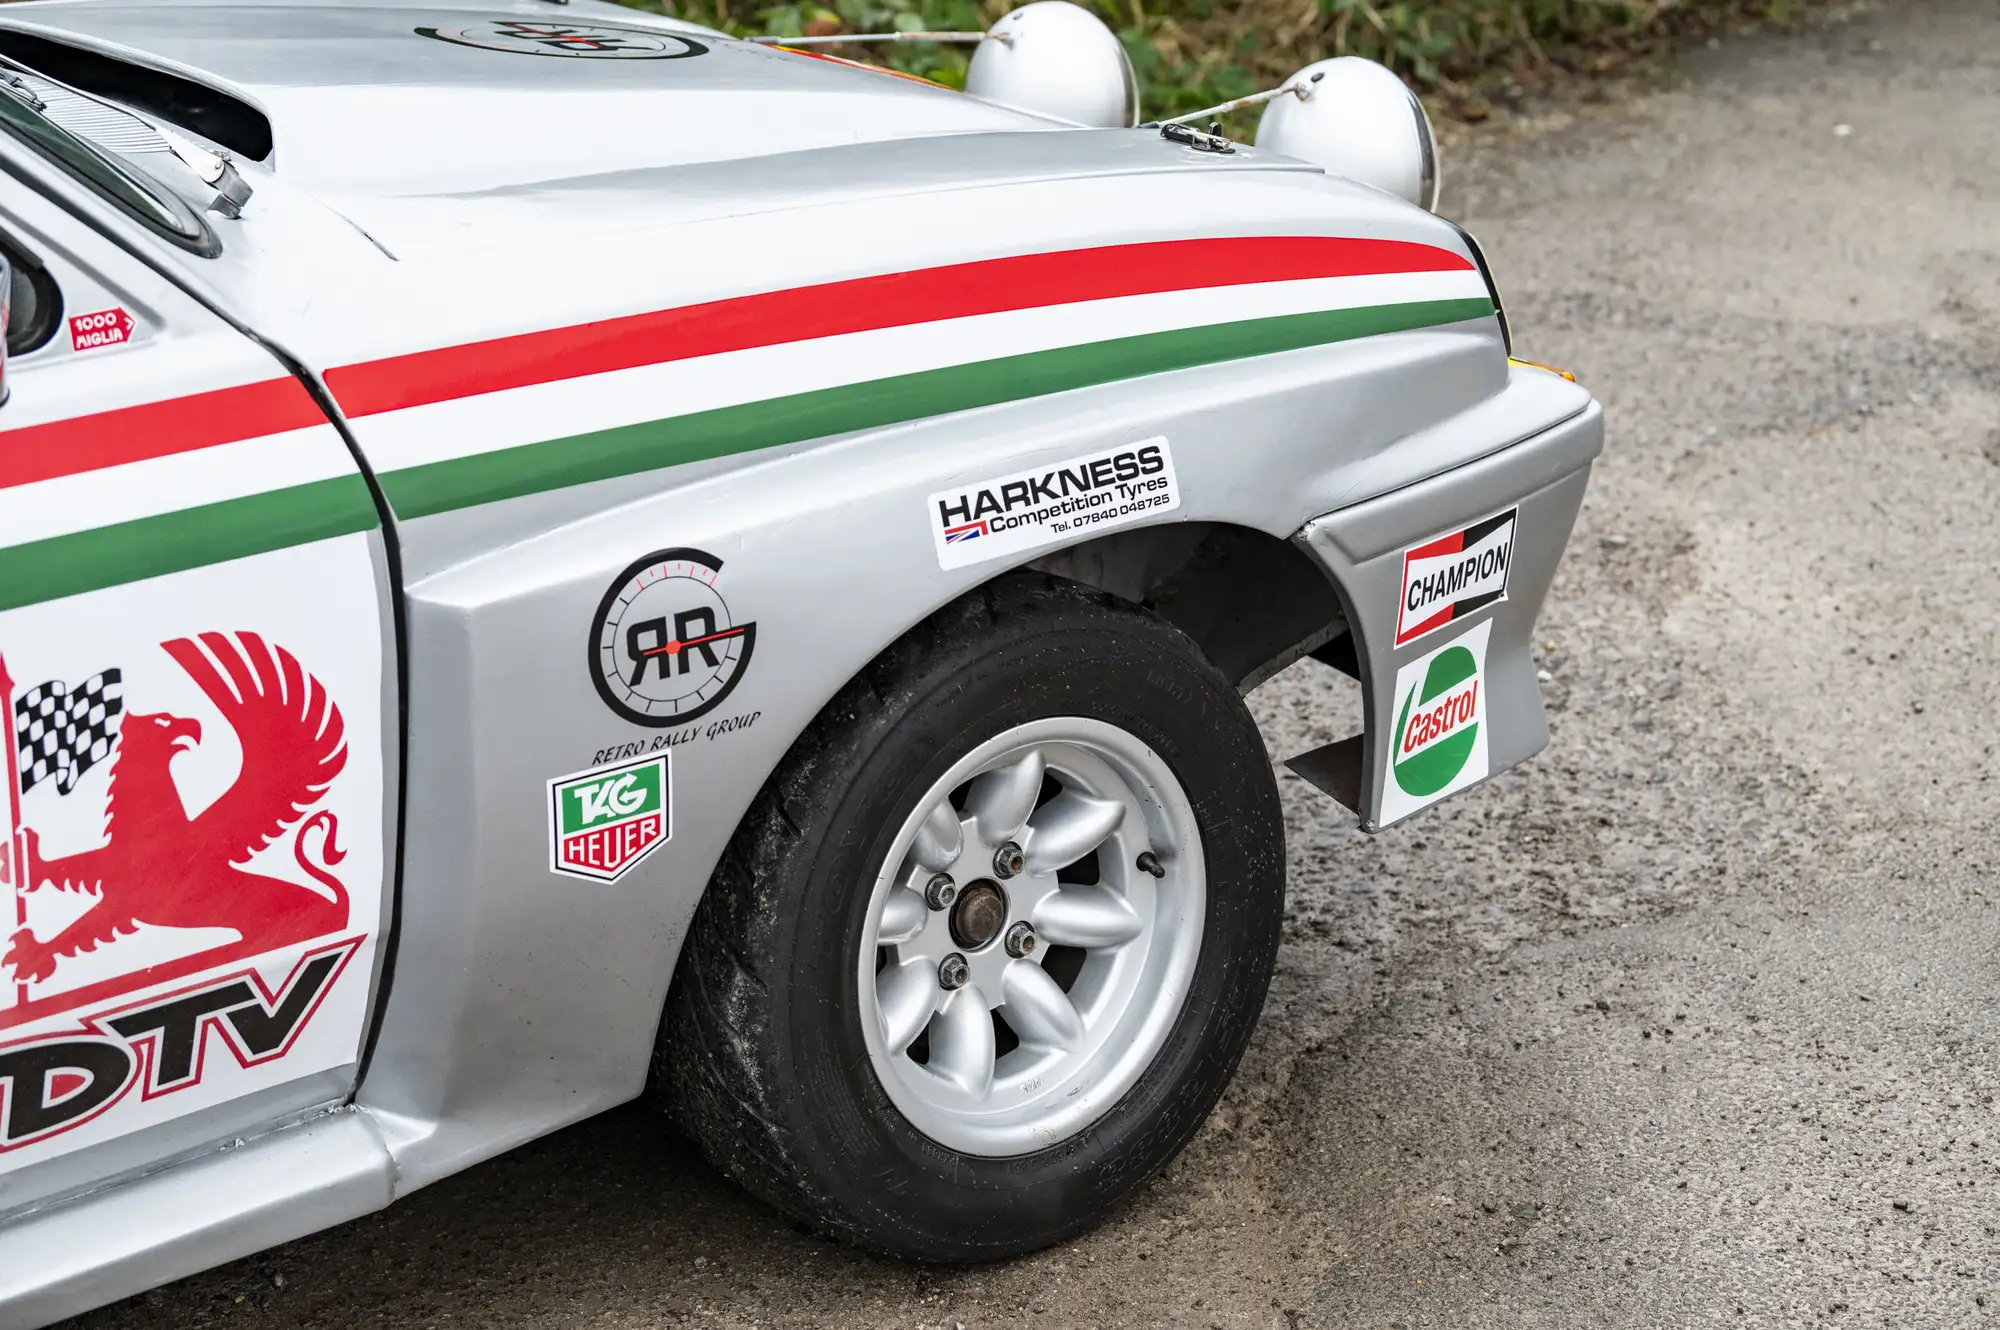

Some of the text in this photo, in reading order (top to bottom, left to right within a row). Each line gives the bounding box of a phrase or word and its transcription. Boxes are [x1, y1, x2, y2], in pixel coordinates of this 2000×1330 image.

[75, 312, 117, 332] 1000
[76, 328, 123, 349] MIGLIA
[938, 445, 1164, 528] HARKNESS
[989, 476, 1168, 534] Competition Tyres
[1051, 493, 1170, 534] Tel. 07840 048725
[1407, 542, 1508, 611] CHAMPION
[592, 711, 761, 766] RETRO RALLY GROUP
[1403, 679, 1478, 753] Castrol
[574, 772, 648, 825] TAG
[568, 818, 657, 869] HEUER
[0, 944, 357, 1145] DTV
